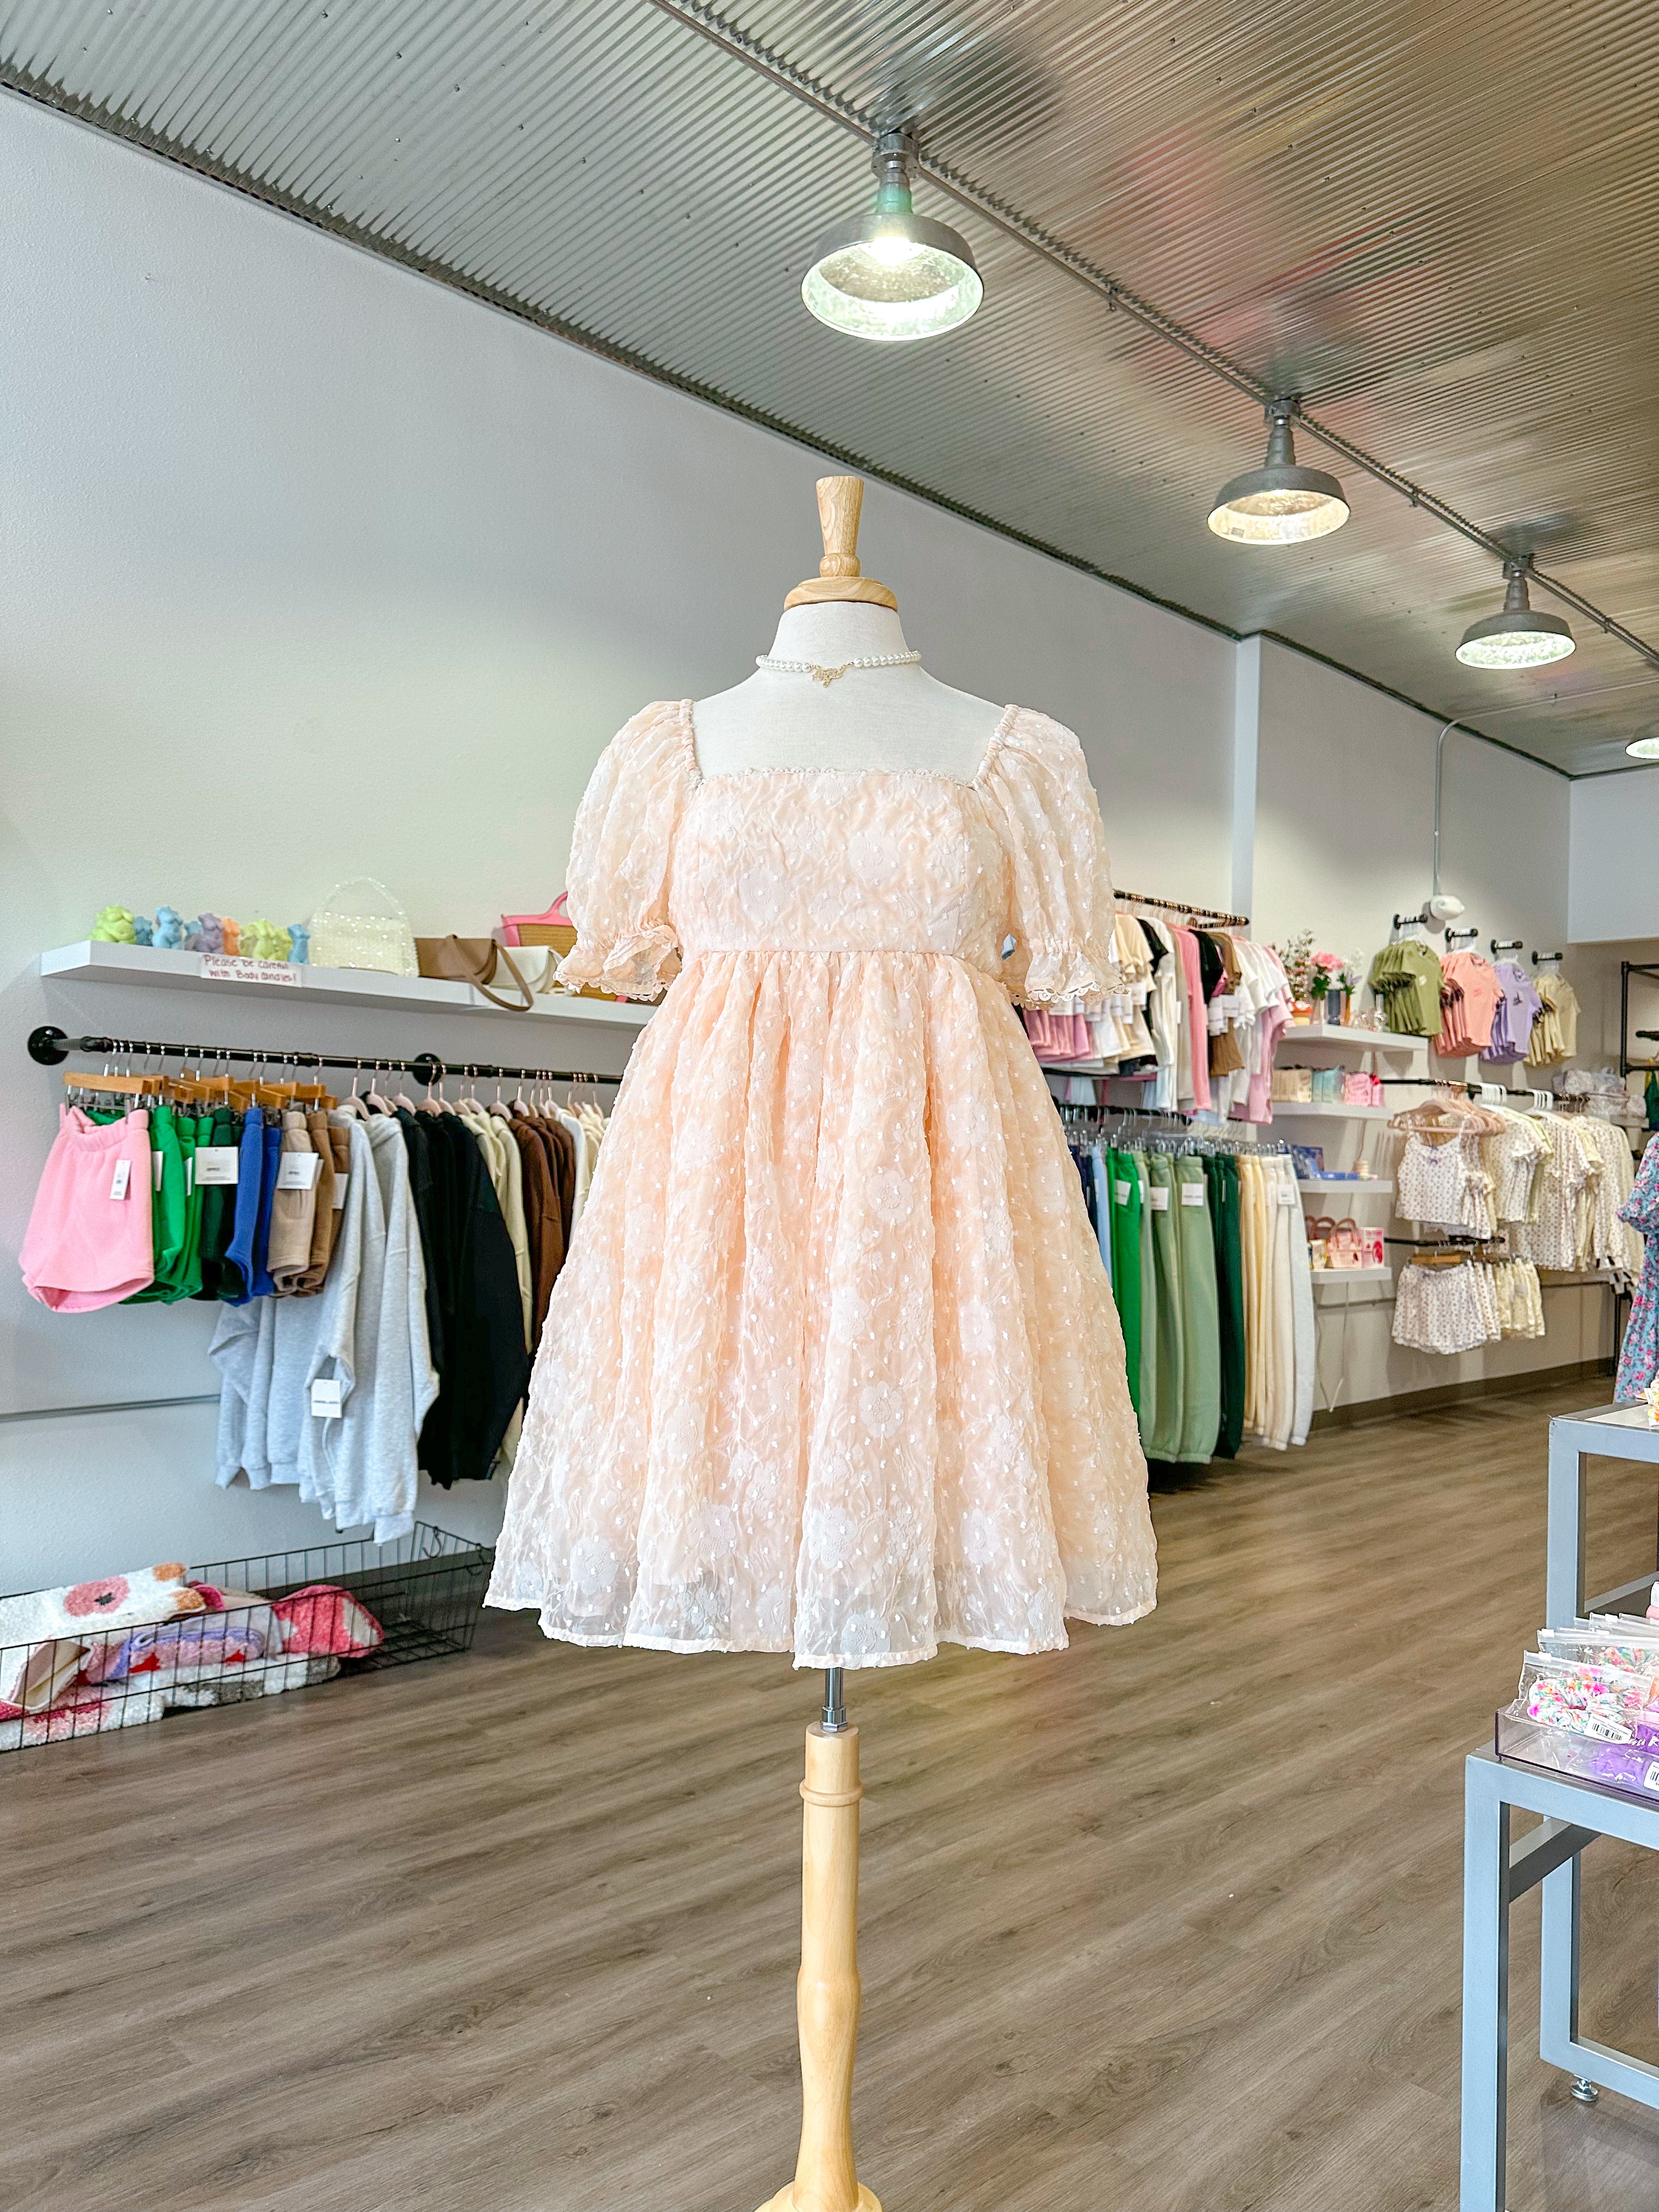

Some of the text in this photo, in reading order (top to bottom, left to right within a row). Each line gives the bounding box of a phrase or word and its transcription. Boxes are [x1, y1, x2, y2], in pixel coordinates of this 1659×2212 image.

[204, 954, 238, 967] Please
[241, 958, 255, 967] be
[209, 969, 230, 977] with
